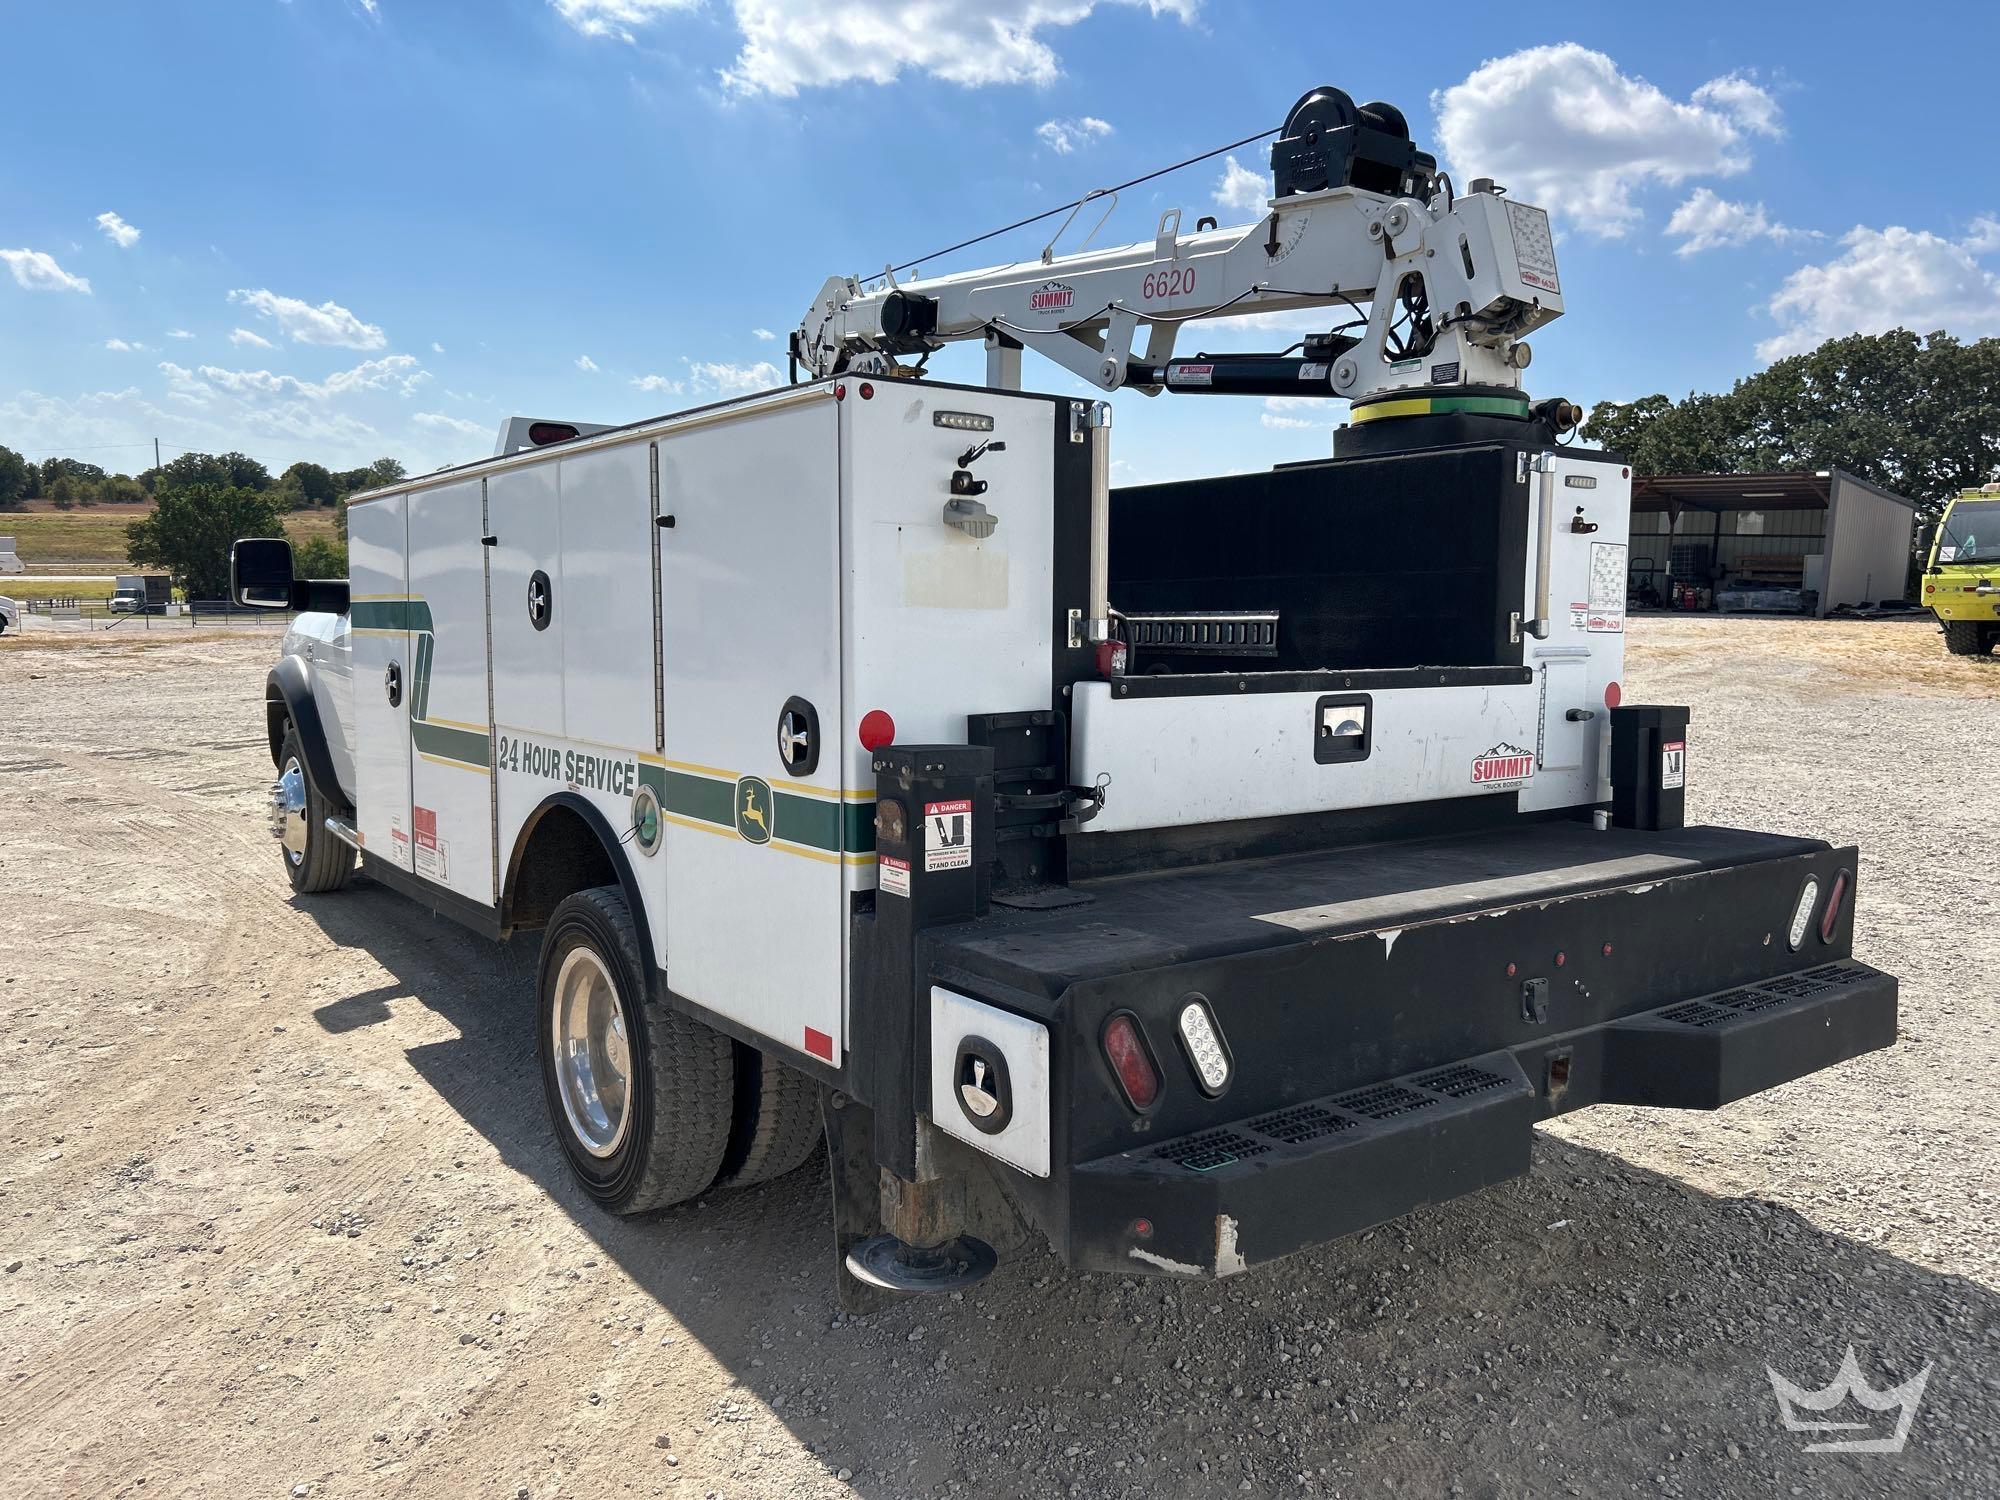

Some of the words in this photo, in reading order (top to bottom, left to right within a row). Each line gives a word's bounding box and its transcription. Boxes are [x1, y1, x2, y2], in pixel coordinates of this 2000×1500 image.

[1143, 267, 1195, 299] 6620
[1031, 291, 1073, 309] SUMMIT
[499, 735, 519, 773] 24
[522, 741, 561, 781] HOUR
[565, 749, 635, 798] SERVICE
[1473, 756, 1533, 781] SUMMIT
[1503, 780, 1523, 788] BODIES
[940, 803, 967, 812] DANGER
[928, 861, 949, 870] STAND
[950, 859, 969, 867] CLEAR
